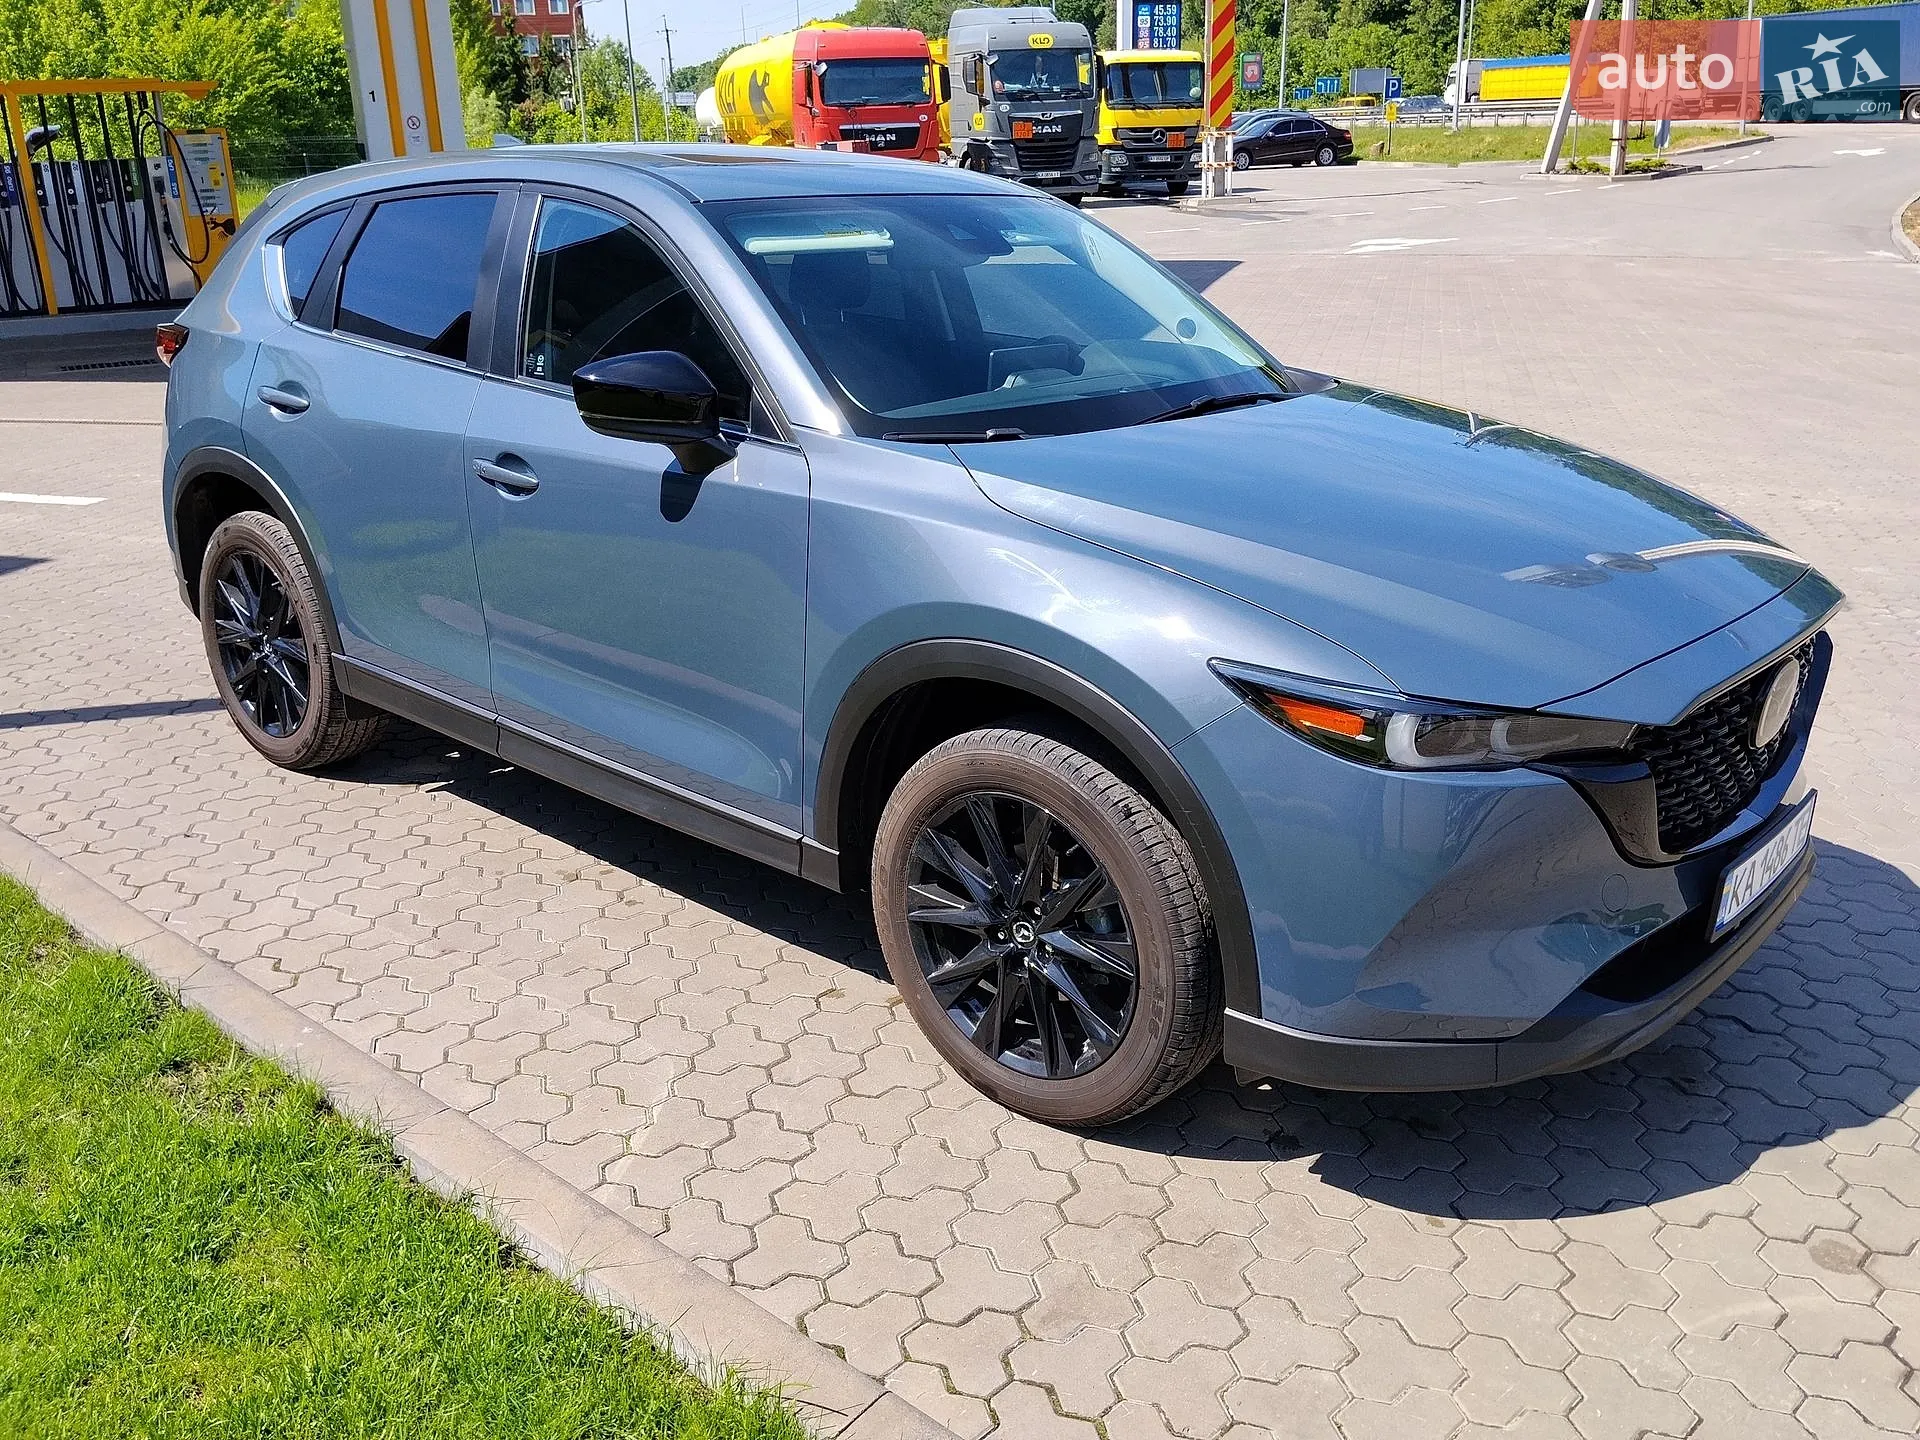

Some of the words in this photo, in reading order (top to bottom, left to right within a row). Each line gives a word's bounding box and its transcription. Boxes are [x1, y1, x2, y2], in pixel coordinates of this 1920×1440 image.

[1154, 5, 1176, 16] 45.59
[1154, 16, 1176, 26] 73.90
[1154, 27, 1176, 37] 78.40
[1153, 38, 1176, 48] 81.70
[1389, 80, 1399, 97] P
[368, 90, 376, 102] 1
[1032, 125, 1062, 134] MAN
[1728, 859, 1756, 914] KA
[1760, 826, 1792, 887] 1486
